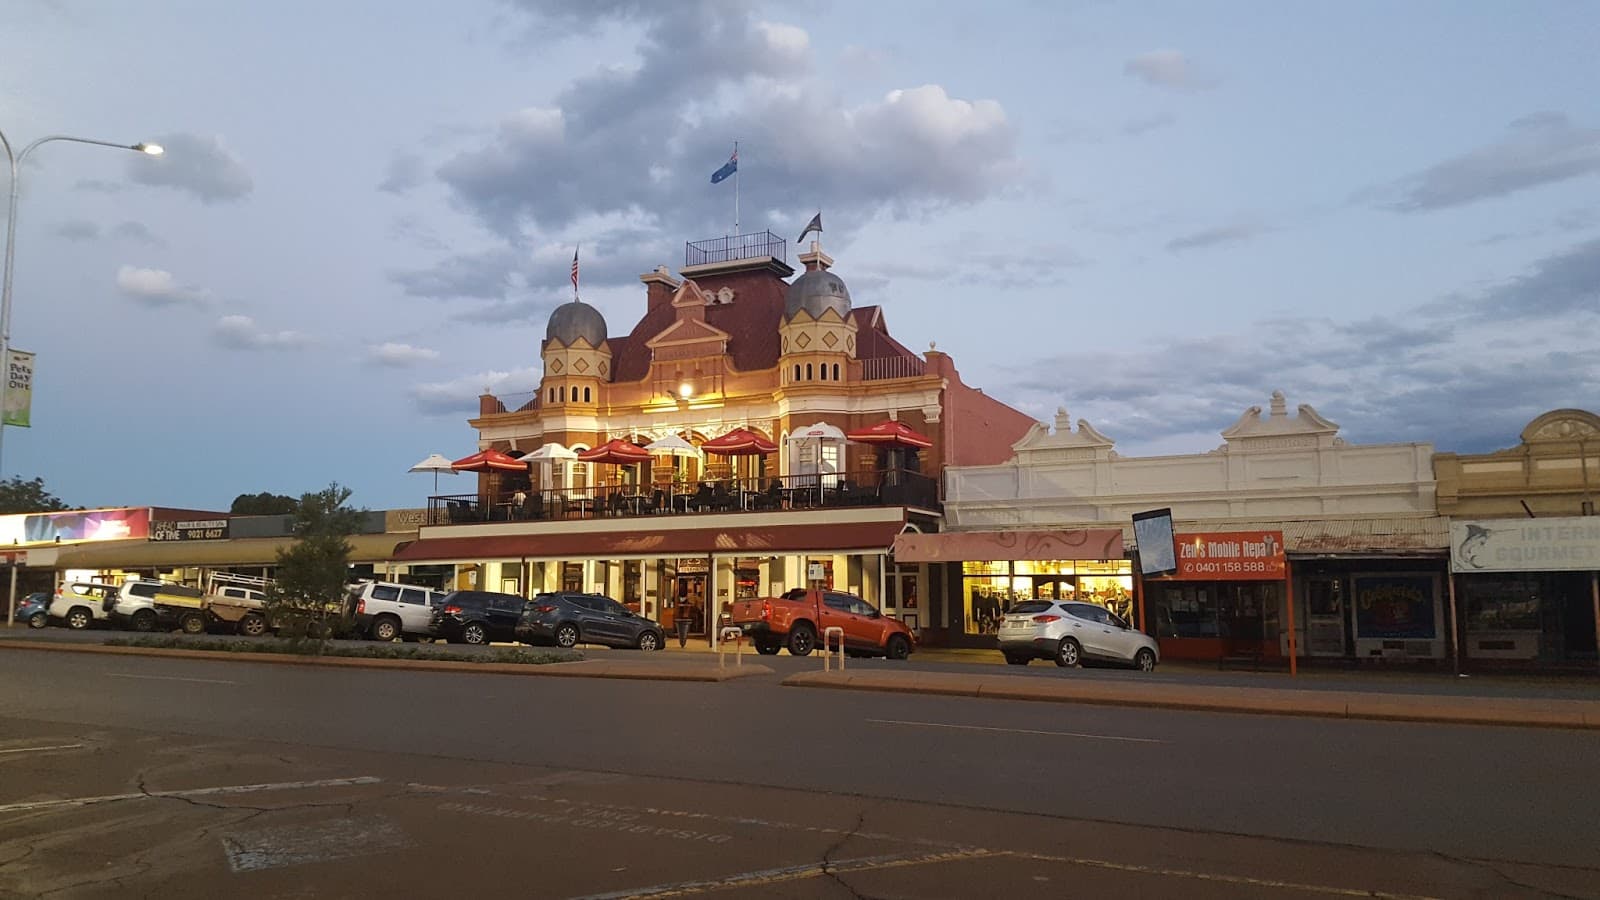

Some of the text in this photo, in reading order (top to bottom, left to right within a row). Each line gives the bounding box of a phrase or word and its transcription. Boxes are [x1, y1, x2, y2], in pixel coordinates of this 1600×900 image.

[10, 363, 32, 374] Pets
[10, 372, 30, 382] Day
[9, 381, 30, 390] Out
[155, 530, 180, 540] OF TIME
[188, 530, 203, 538] 9021
[1208, 541, 1240, 557] Mobile
[1243, 535, 1279, 558] Repair
[1196, 562, 1265, 572] 0401 158 588
